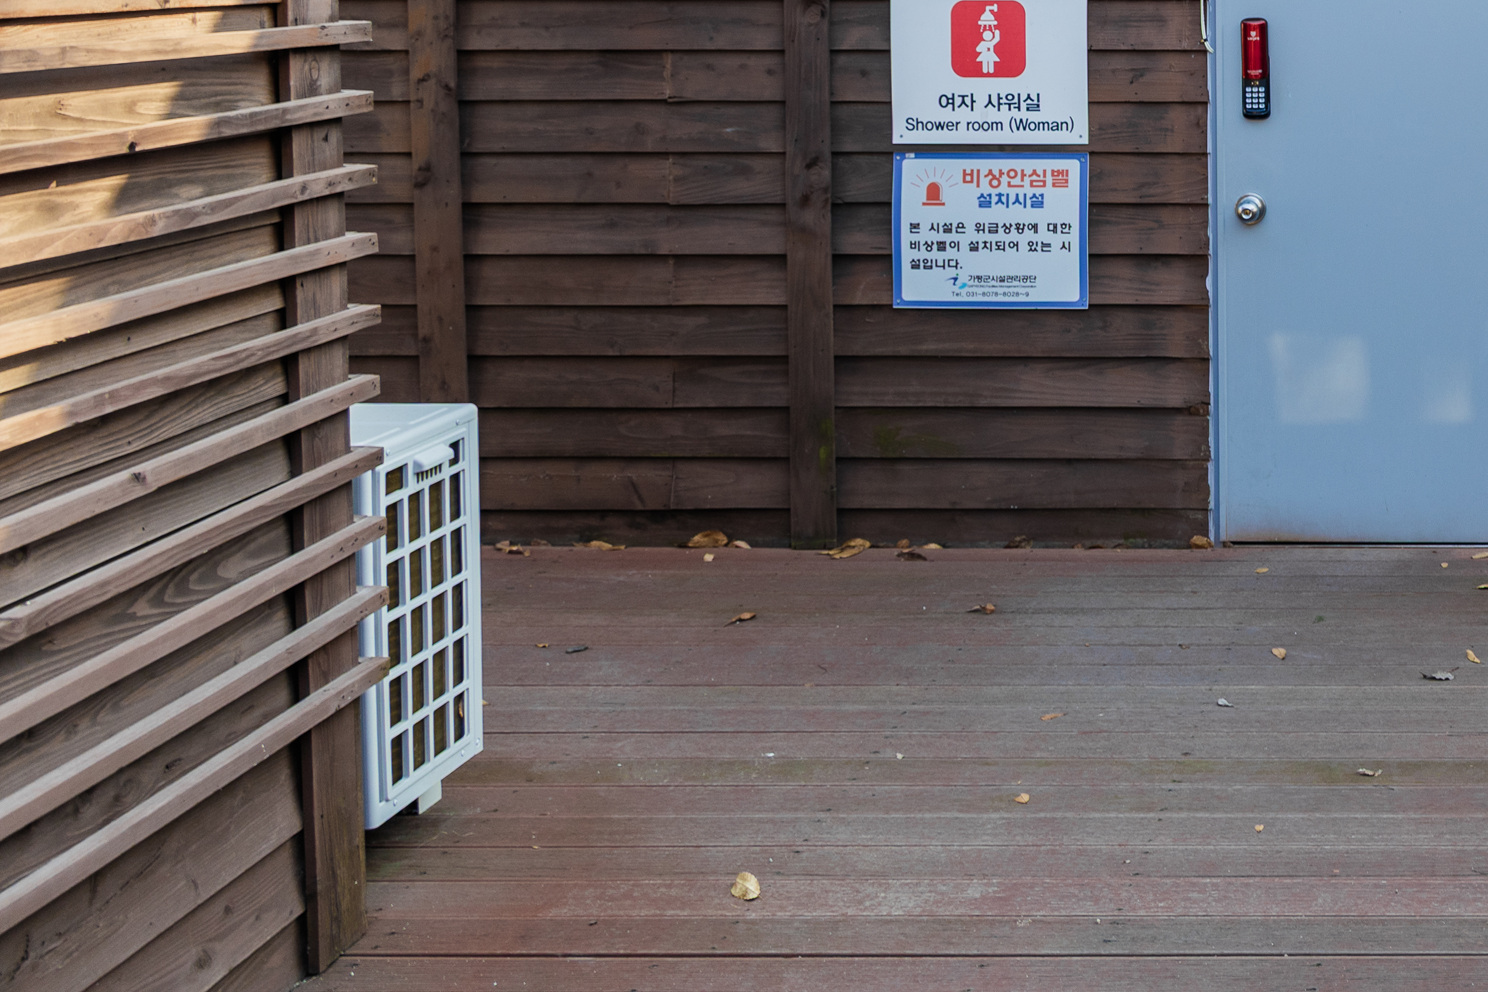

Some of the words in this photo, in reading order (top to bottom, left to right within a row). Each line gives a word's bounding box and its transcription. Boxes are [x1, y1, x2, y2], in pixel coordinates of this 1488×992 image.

[938, 93, 976, 112] 여자
[984, 93, 1041, 112] 샤워실
[905, 117, 961, 132] Shower
[966, 120, 1004, 132] room
[1008, 116, 1075, 134] (Woman)
[962, 168, 1069, 189] 비상안심벨
[977, 193, 1045, 209] 설치시설
[909, 222, 921, 234] 본
[928, 222, 967, 234] 시설은
[974, 222, 1039, 235] 위급상황에
[1046, 222, 1072, 235] 대한
[909, 240, 961, 253] 비상벨이
[968, 240, 1020, 253] 설치되어
[1027, 240, 1052, 253] 있는
[1059, 240, 1071, 253] 시
[909, 258, 963, 270] 설입니다.
[967, 274, 1037, 284] 가평군시설관리공단
